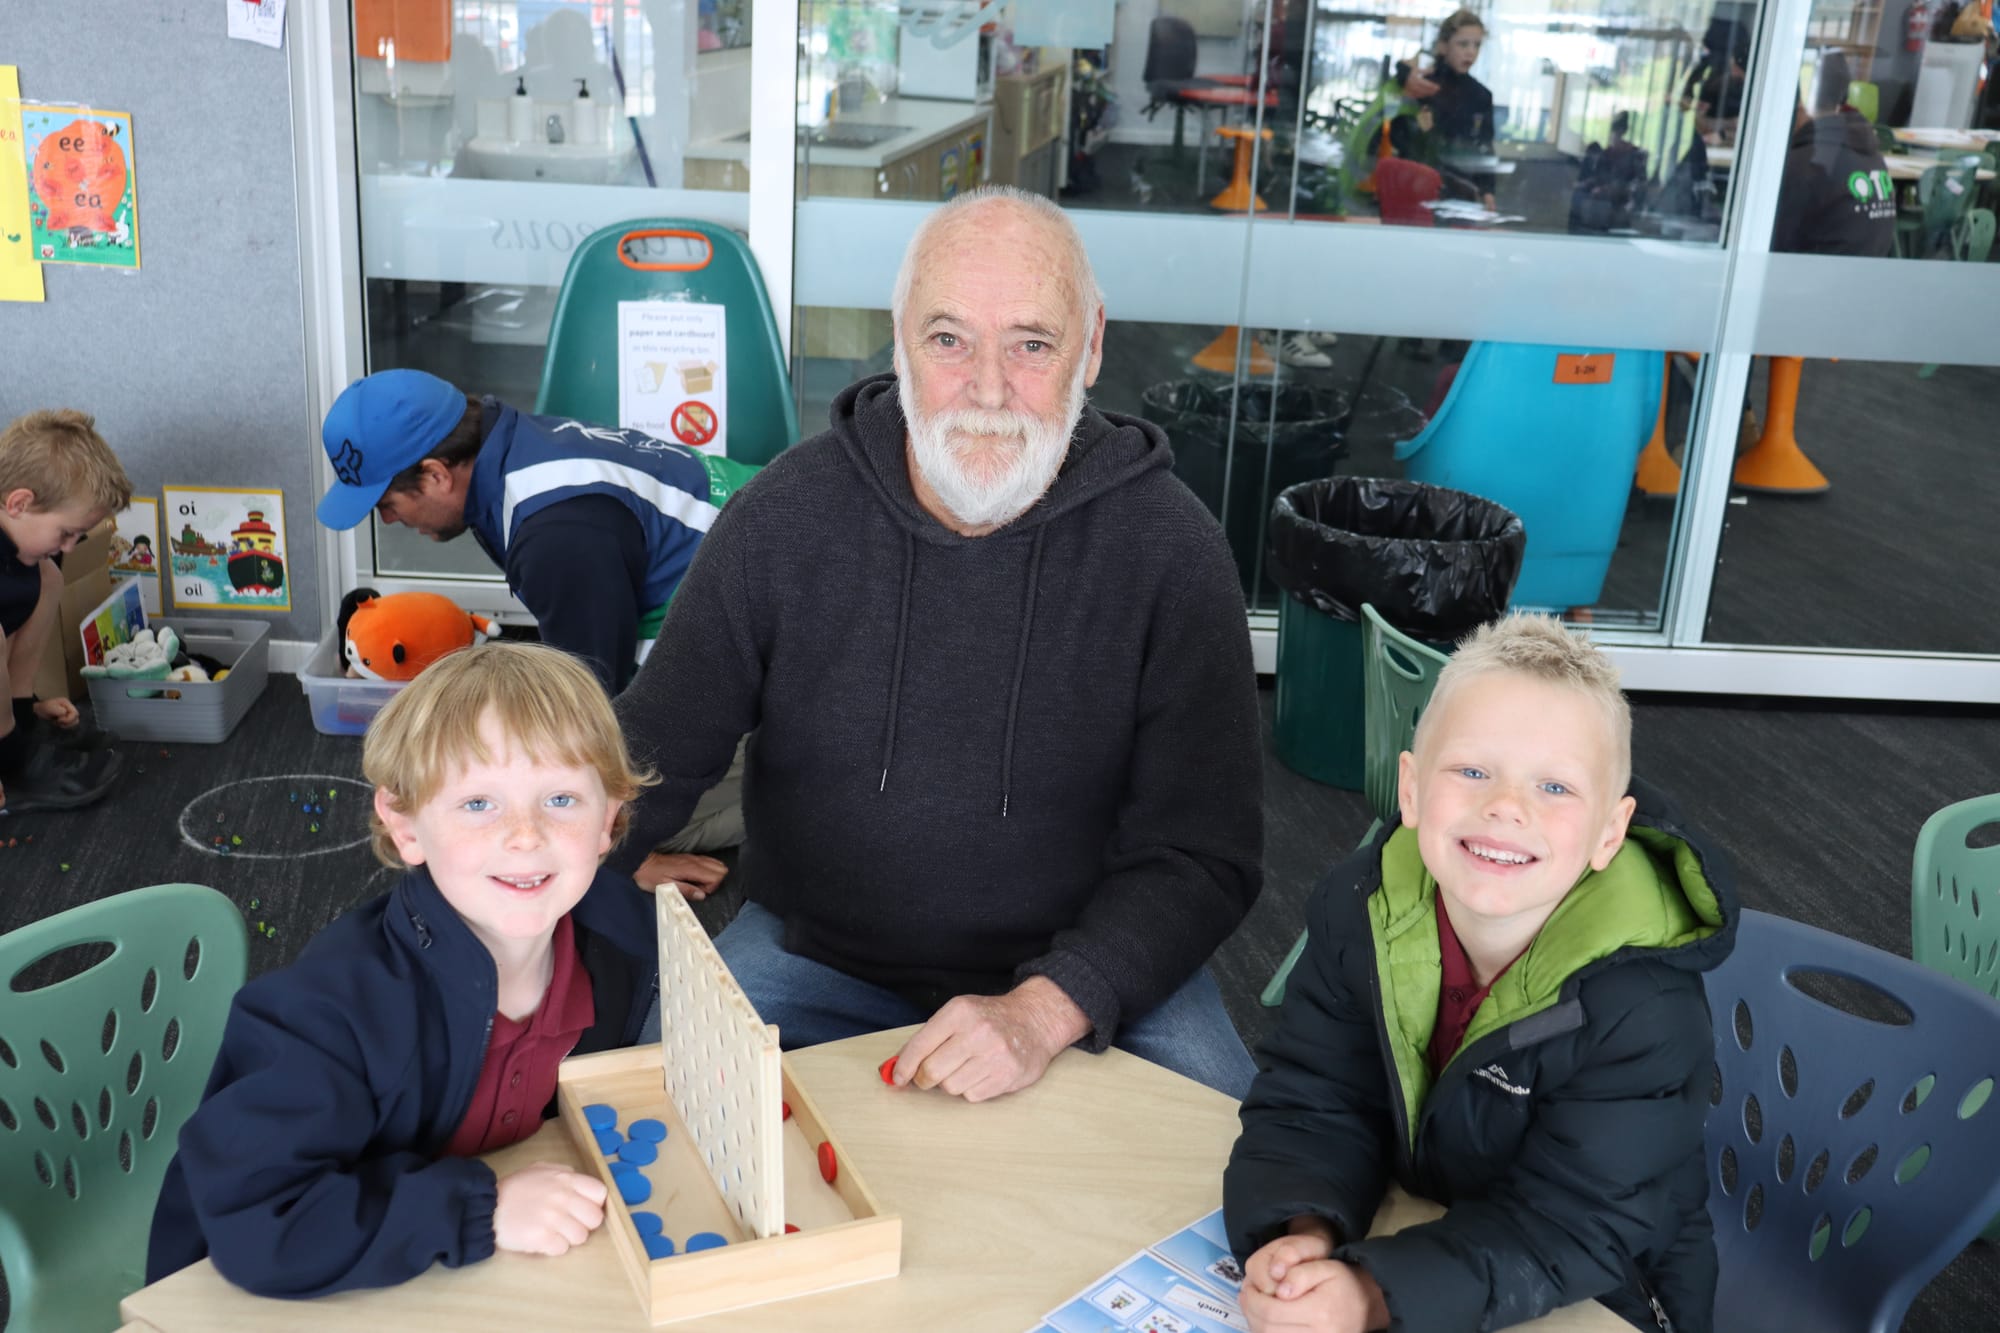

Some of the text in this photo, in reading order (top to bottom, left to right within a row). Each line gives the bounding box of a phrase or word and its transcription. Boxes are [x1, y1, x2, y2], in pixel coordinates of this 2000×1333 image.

[59, 136, 85, 152] ee
[75, 193, 103, 209] ea
[629, 328, 716, 339] paper and cardboard
[179, 501, 197, 516] oi
[184, 584, 203, 597] oil
[1197, 1301, 1230, 1319] Lunch
